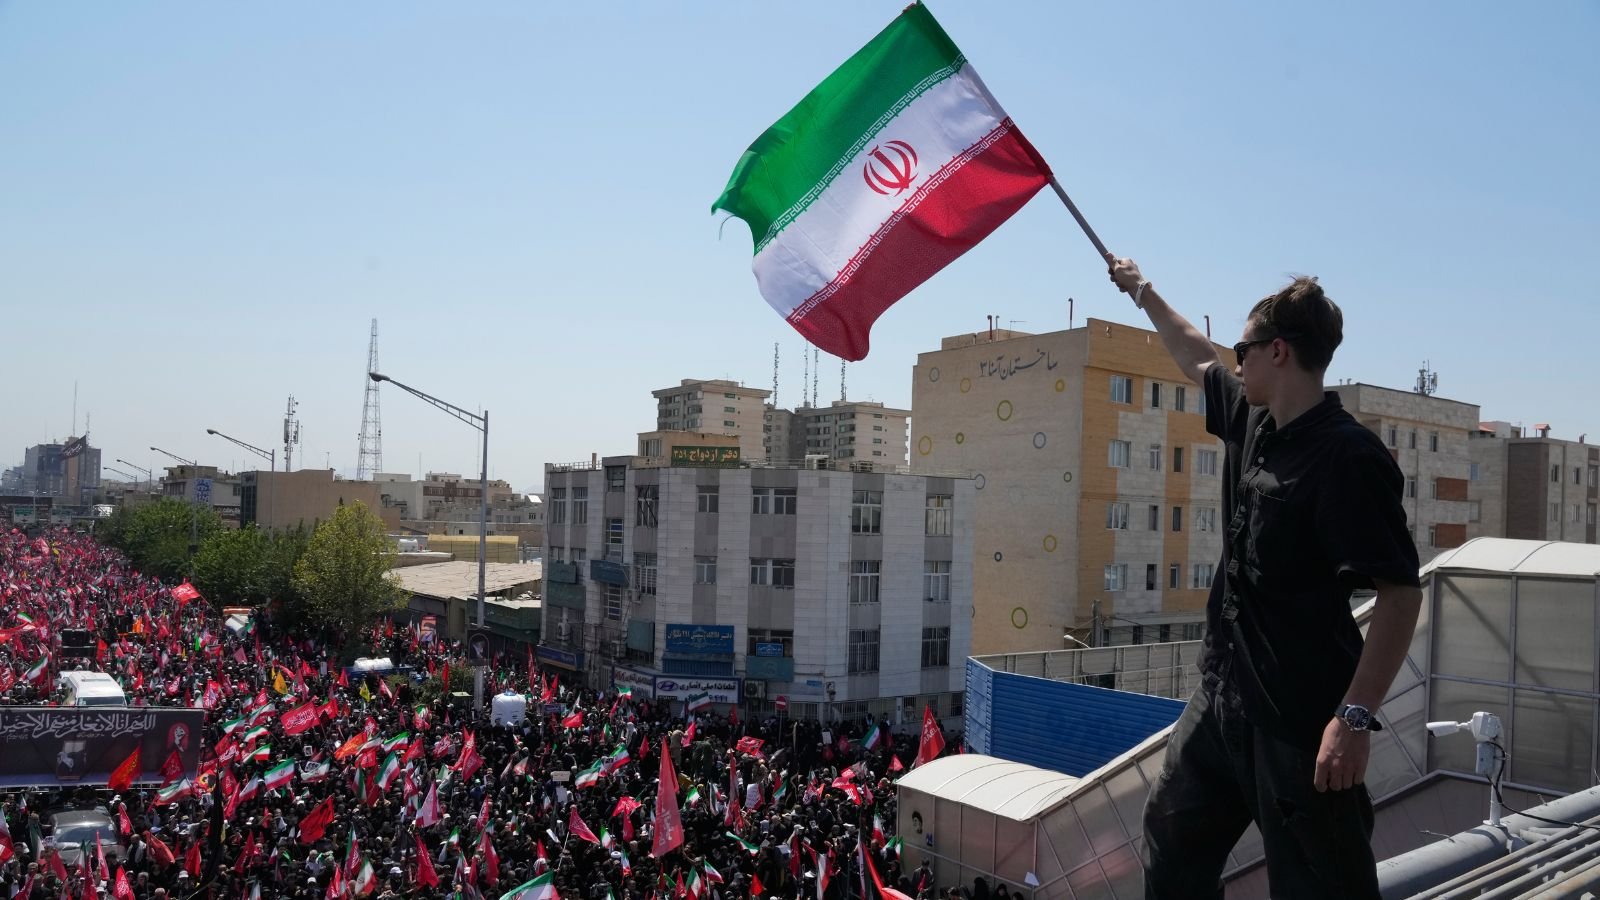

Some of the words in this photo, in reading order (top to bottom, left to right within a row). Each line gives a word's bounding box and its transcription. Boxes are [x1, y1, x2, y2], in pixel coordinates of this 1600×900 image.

[1000, 348, 1058, 380] ساختمان
[689, 448, 718, 462] ازدواج
[720, 449, 738, 462] دفتر
[701, 682, 717, 691] اصلی
[718, 682, 736, 690] قطعات
